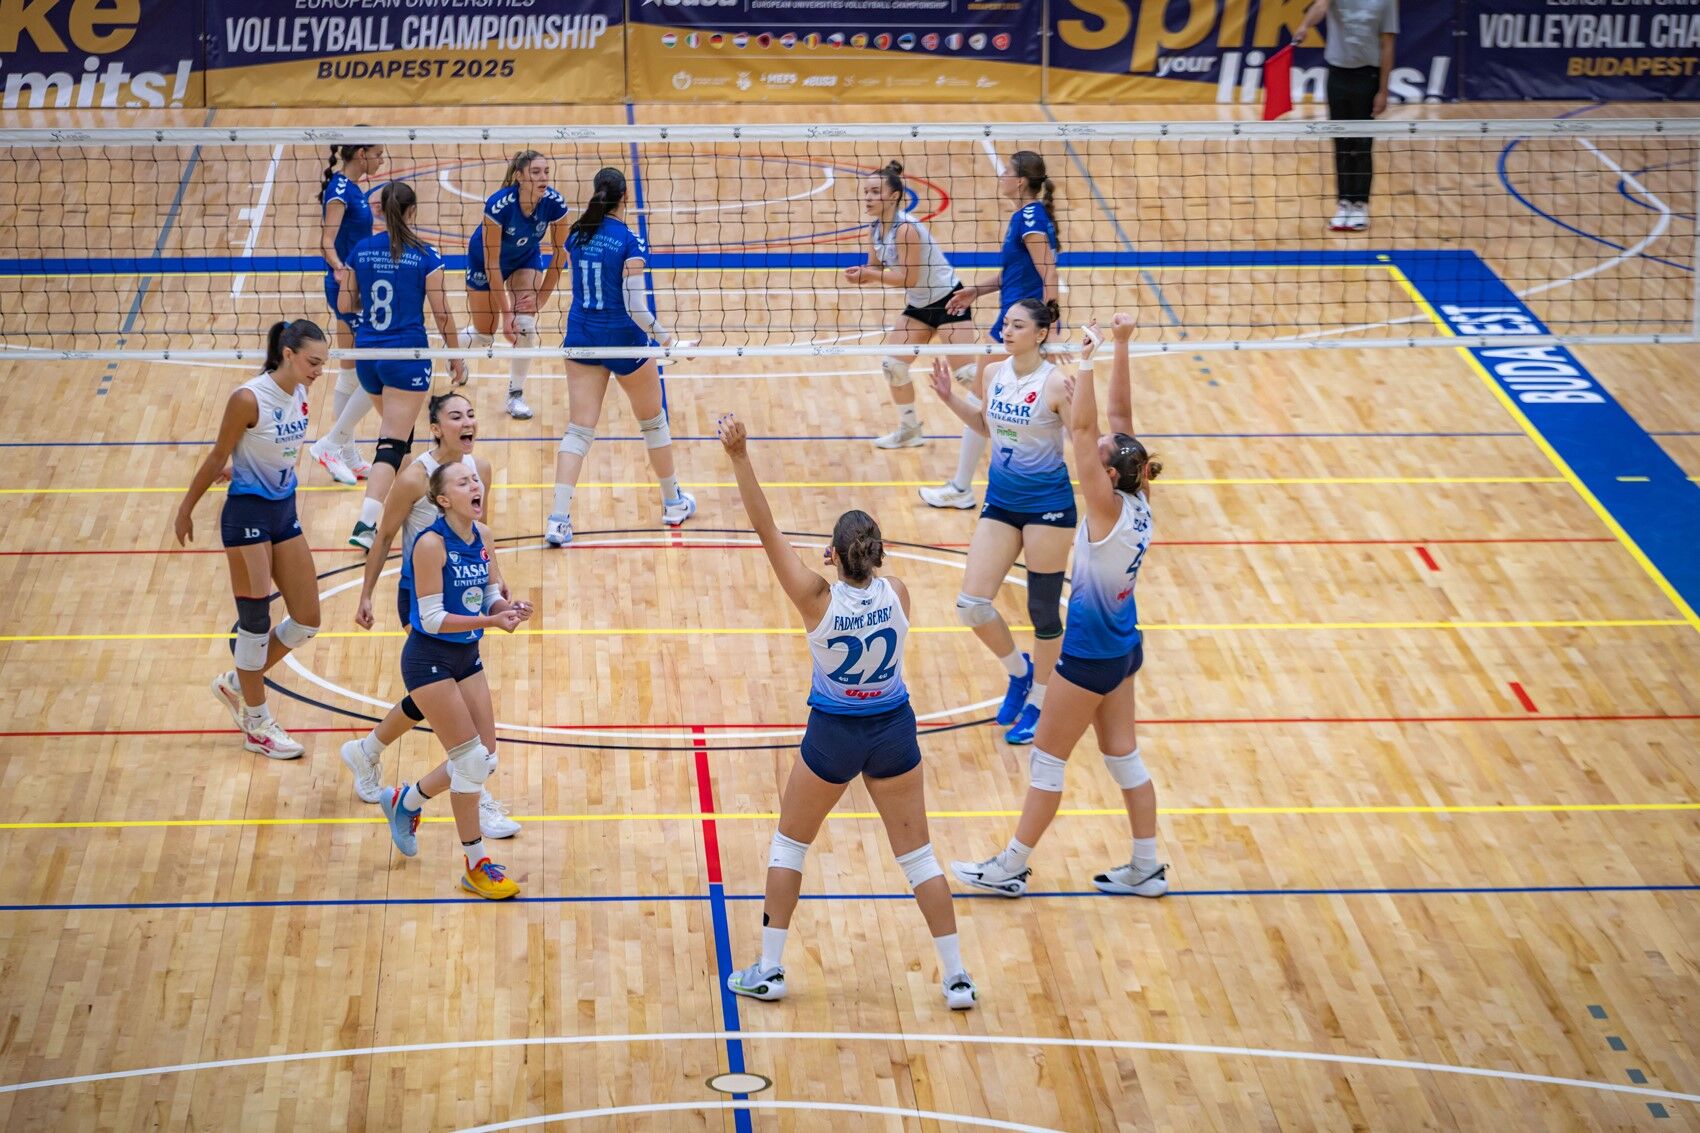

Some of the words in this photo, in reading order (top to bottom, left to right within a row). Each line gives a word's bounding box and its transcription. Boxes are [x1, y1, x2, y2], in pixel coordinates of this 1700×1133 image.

[226, 16, 395, 53] VOLLEYBALL
[401, 14, 607, 50] CHAMPIONSHIP
[1479, 14, 1646, 48] VOLLEYBALL
[317, 60, 449, 79] BUDAPEST
[450, 59, 515, 78] 2025
[1156, 54, 1217, 76] your
[1567, 57, 1696, 76] BUDAPEST
[579, 260, 603, 309] 11
[370, 280, 393, 331] 8
[1440, 304, 1607, 404] BUDAEST
[1000, 447, 1014, 468] 7
[244, 527, 260, 539] 15
[827, 627, 898, 685] 22
